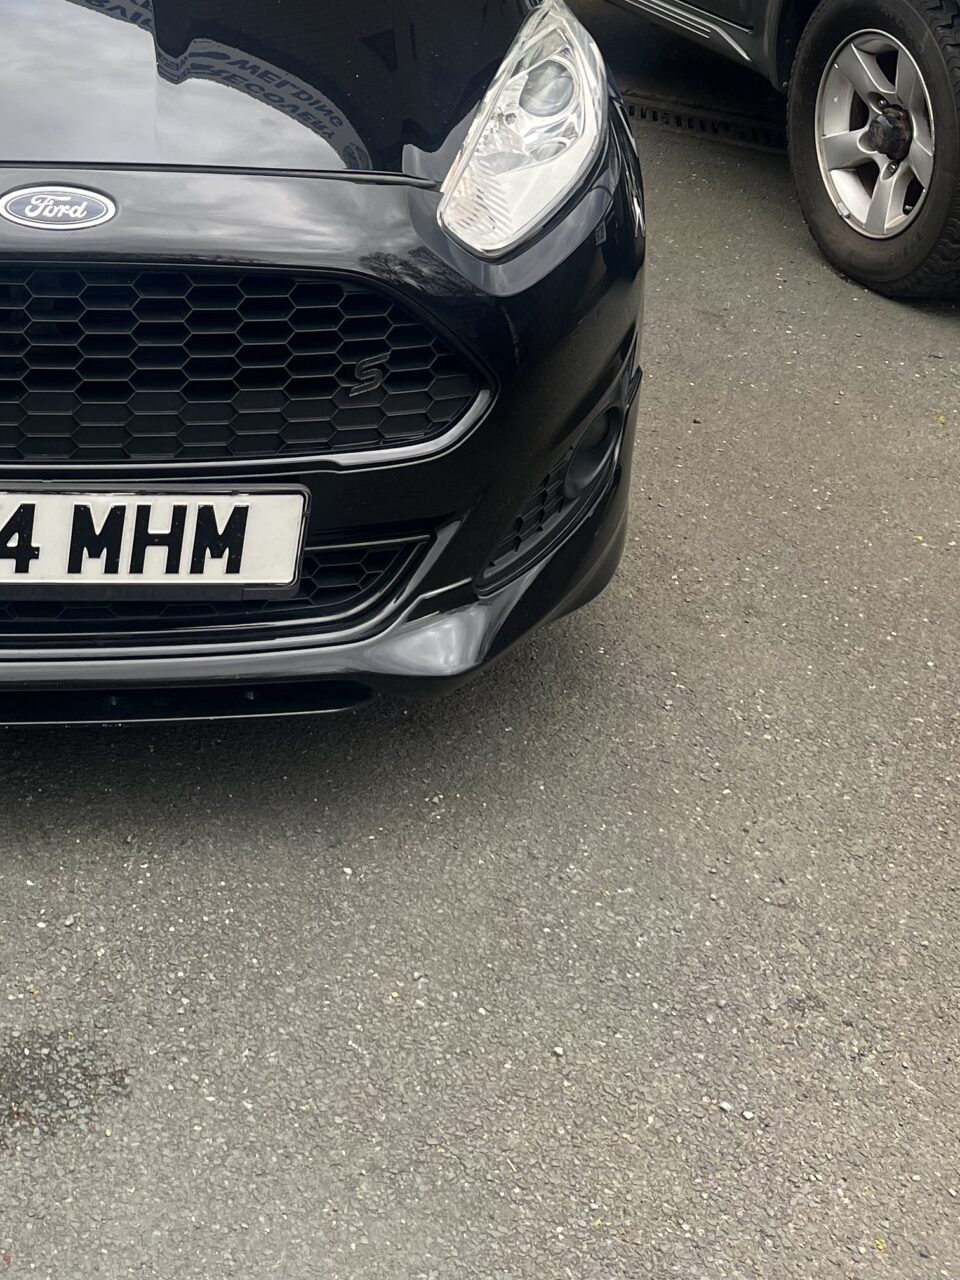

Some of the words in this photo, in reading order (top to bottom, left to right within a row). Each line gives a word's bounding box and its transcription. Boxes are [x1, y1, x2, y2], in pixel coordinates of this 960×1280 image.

[24, 194, 88, 220] Ford
[349, 351, 392, 398] S
[67, 503, 250, 575] MHM
